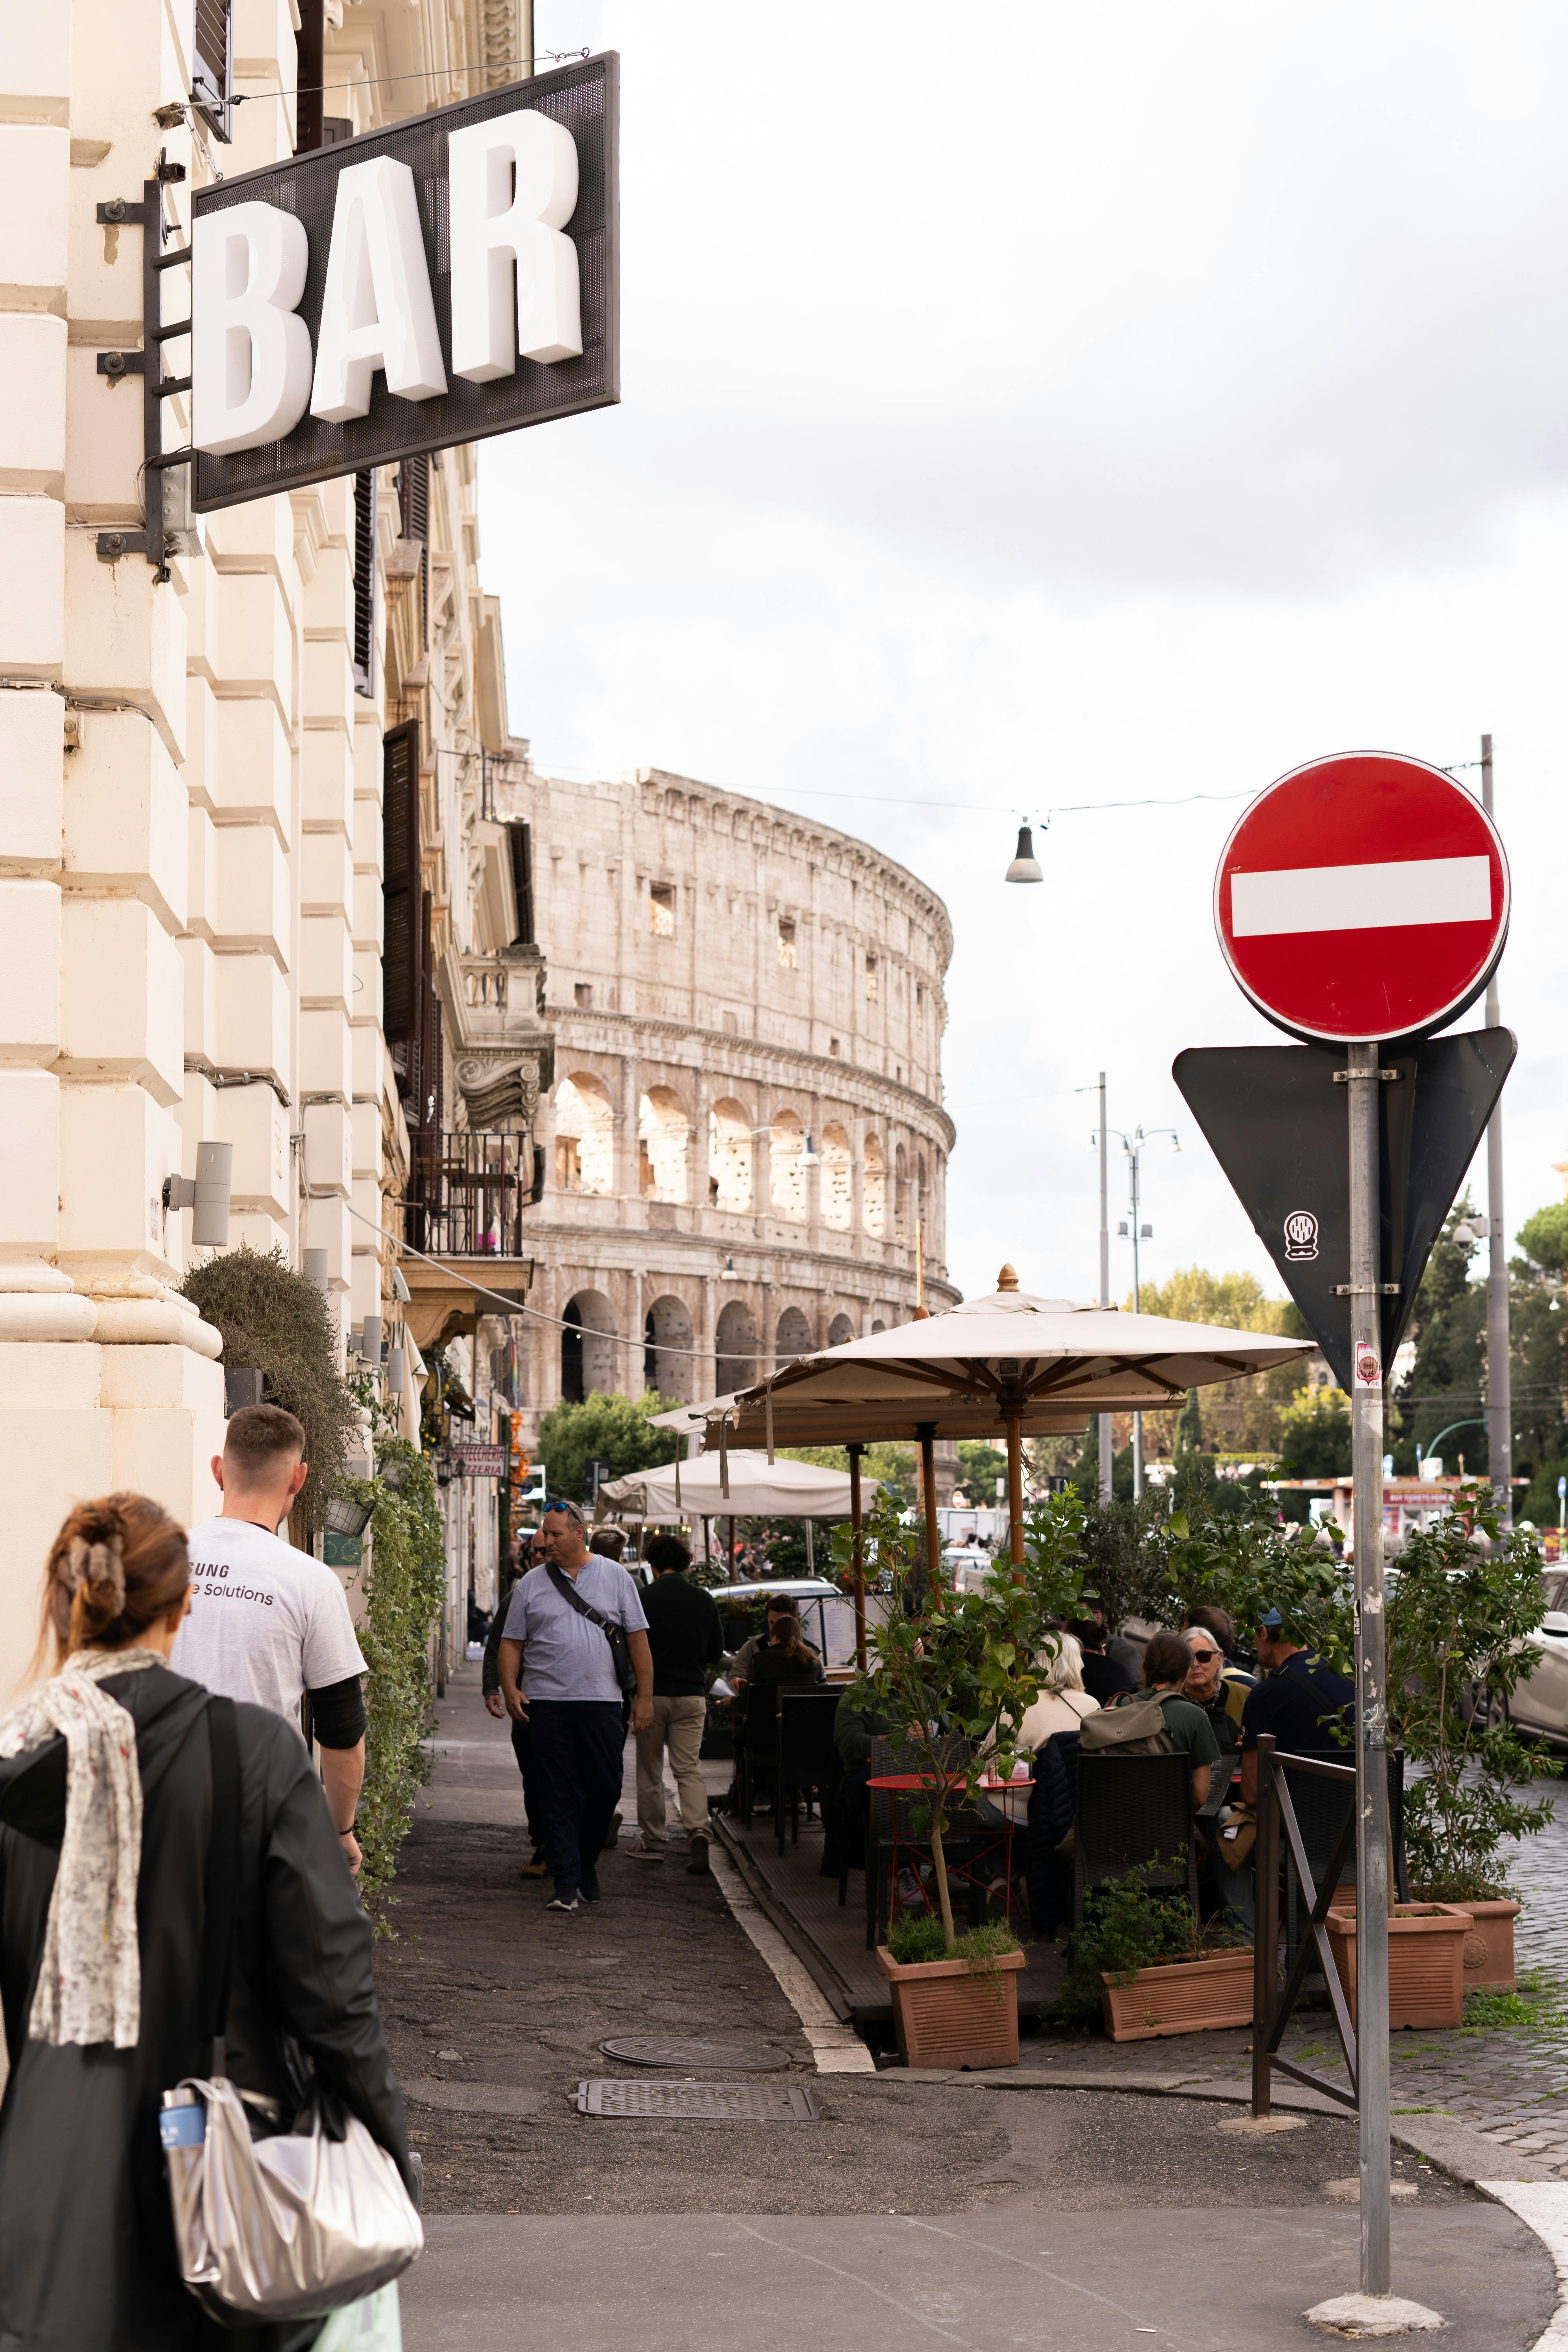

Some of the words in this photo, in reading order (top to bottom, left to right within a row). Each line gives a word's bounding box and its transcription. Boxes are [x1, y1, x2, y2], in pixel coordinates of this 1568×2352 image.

[192, 109, 583, 456] BAR
[454, 1465, 501, 1474] PZZERIA
[204, 1583, 274, 1606] Solutions
